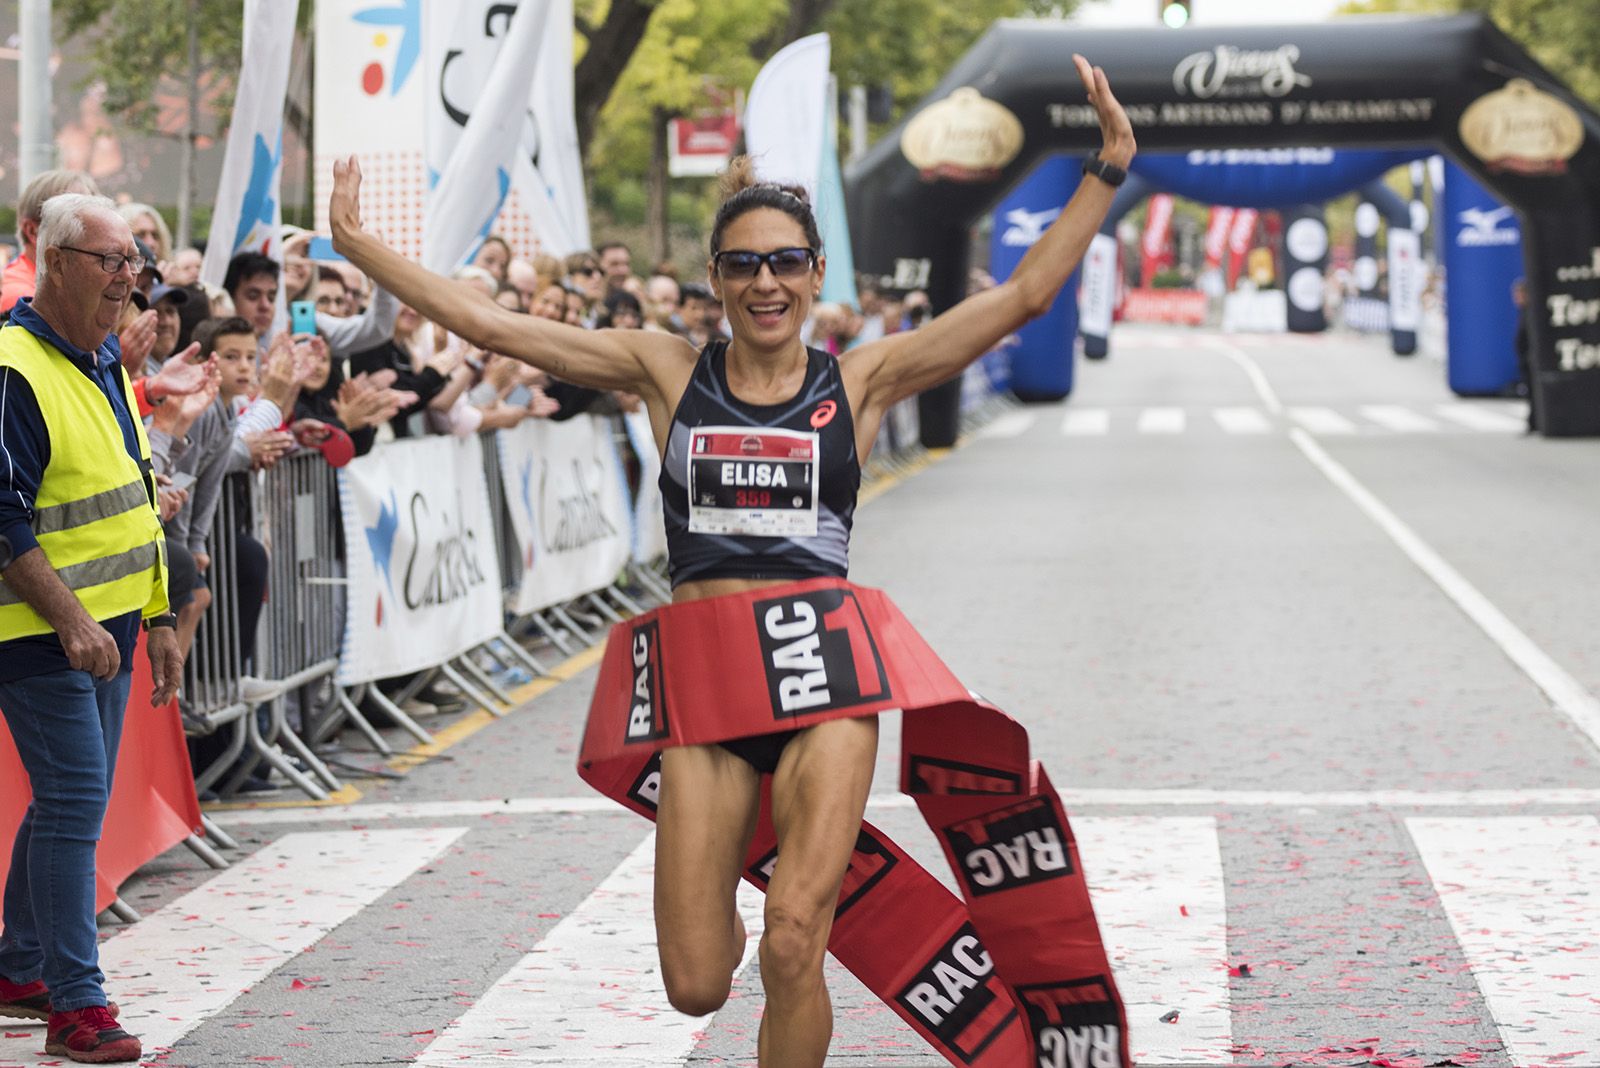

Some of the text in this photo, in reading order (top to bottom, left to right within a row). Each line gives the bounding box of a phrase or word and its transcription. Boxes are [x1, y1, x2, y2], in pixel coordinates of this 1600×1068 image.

[721, 462, 788, 488] ELISA
[628, 632, 651, 738] RAC
[765, 595, 882, 713] RAC 1
[966, 826, 1068, 887] RAC
[904, 934, 994, 1027] RAC
[1039, 1023, 1122, 1068] RAC
